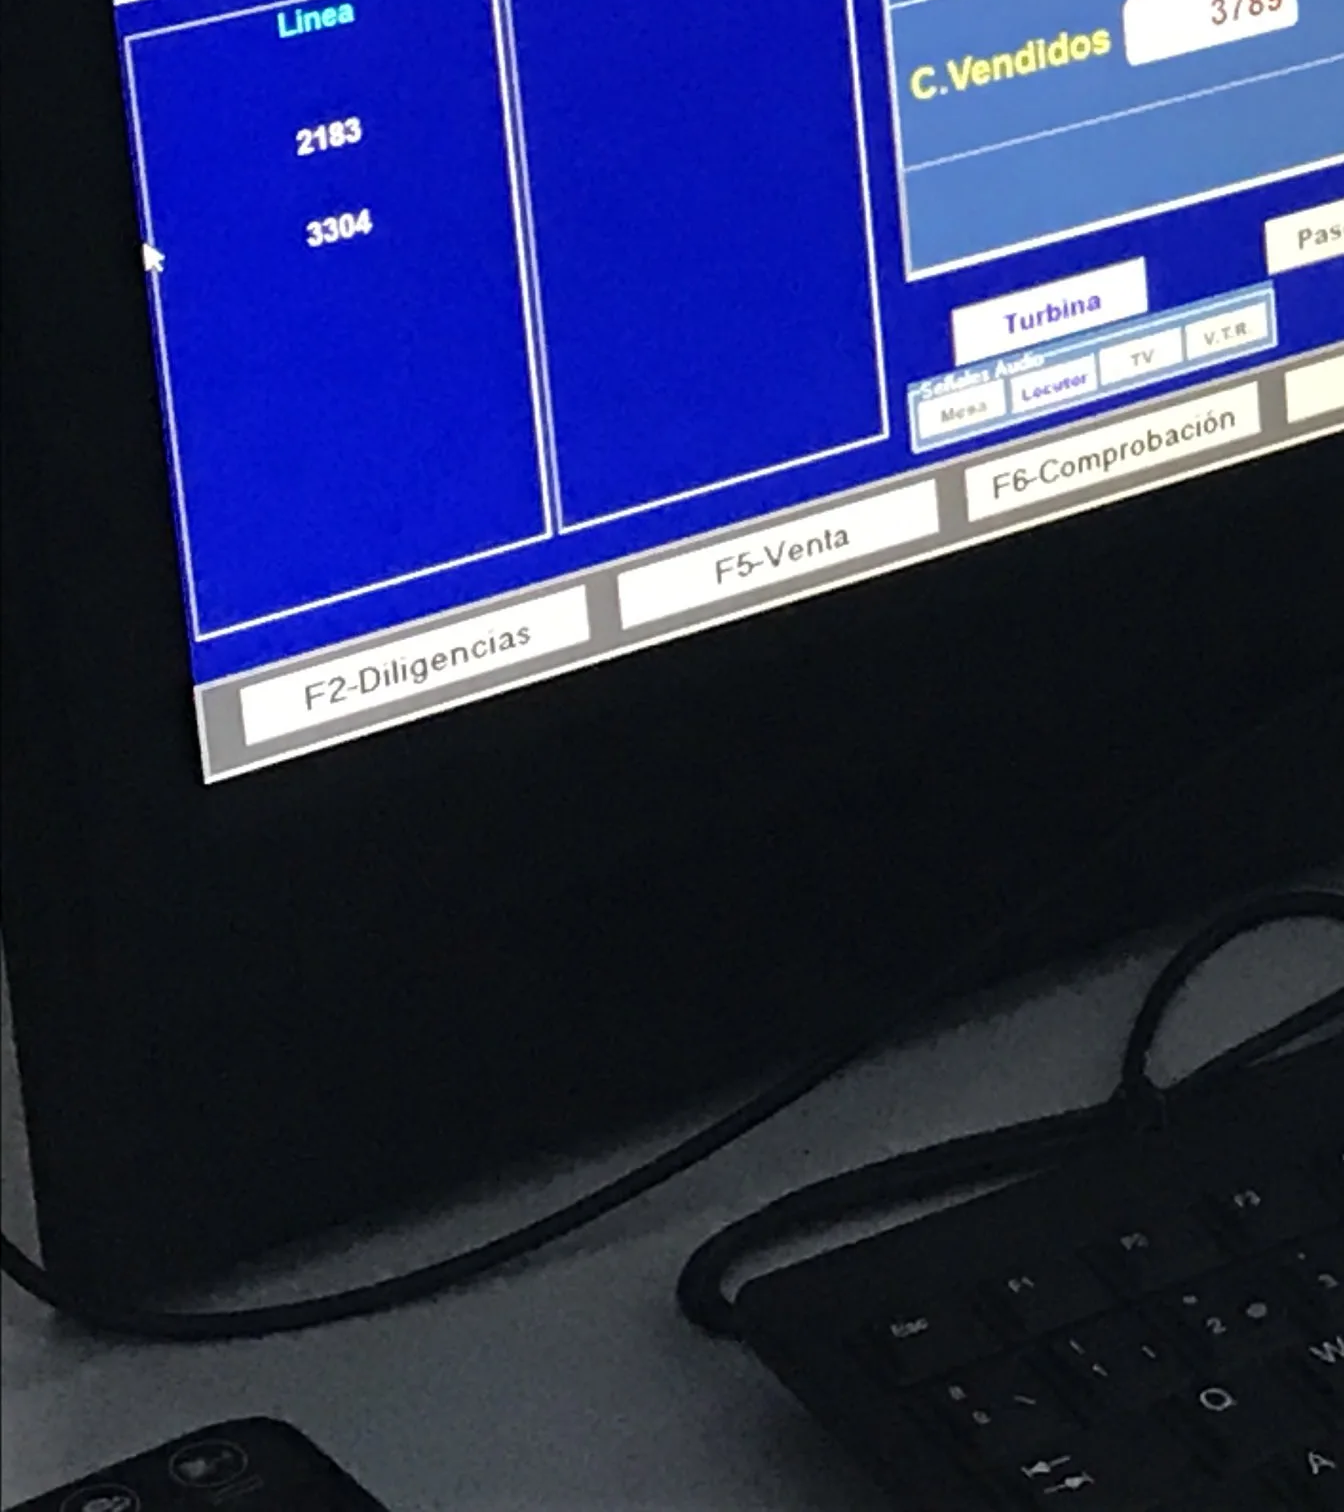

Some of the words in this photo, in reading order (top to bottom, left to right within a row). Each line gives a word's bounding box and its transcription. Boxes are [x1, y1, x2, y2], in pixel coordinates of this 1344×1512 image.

[911, 25, 1112, 100] C.Vendidos
[296, 116, 363, 156] 2183
[306, 208, 373, 248] 3304
[1003, 291, 1102, 336] Turbina
[991, 403, 1238, 501] F6-Comprobación
[713, 525, 850, 586] F5-Venta
[303, 623, 532, 713] F2-Diligencias
